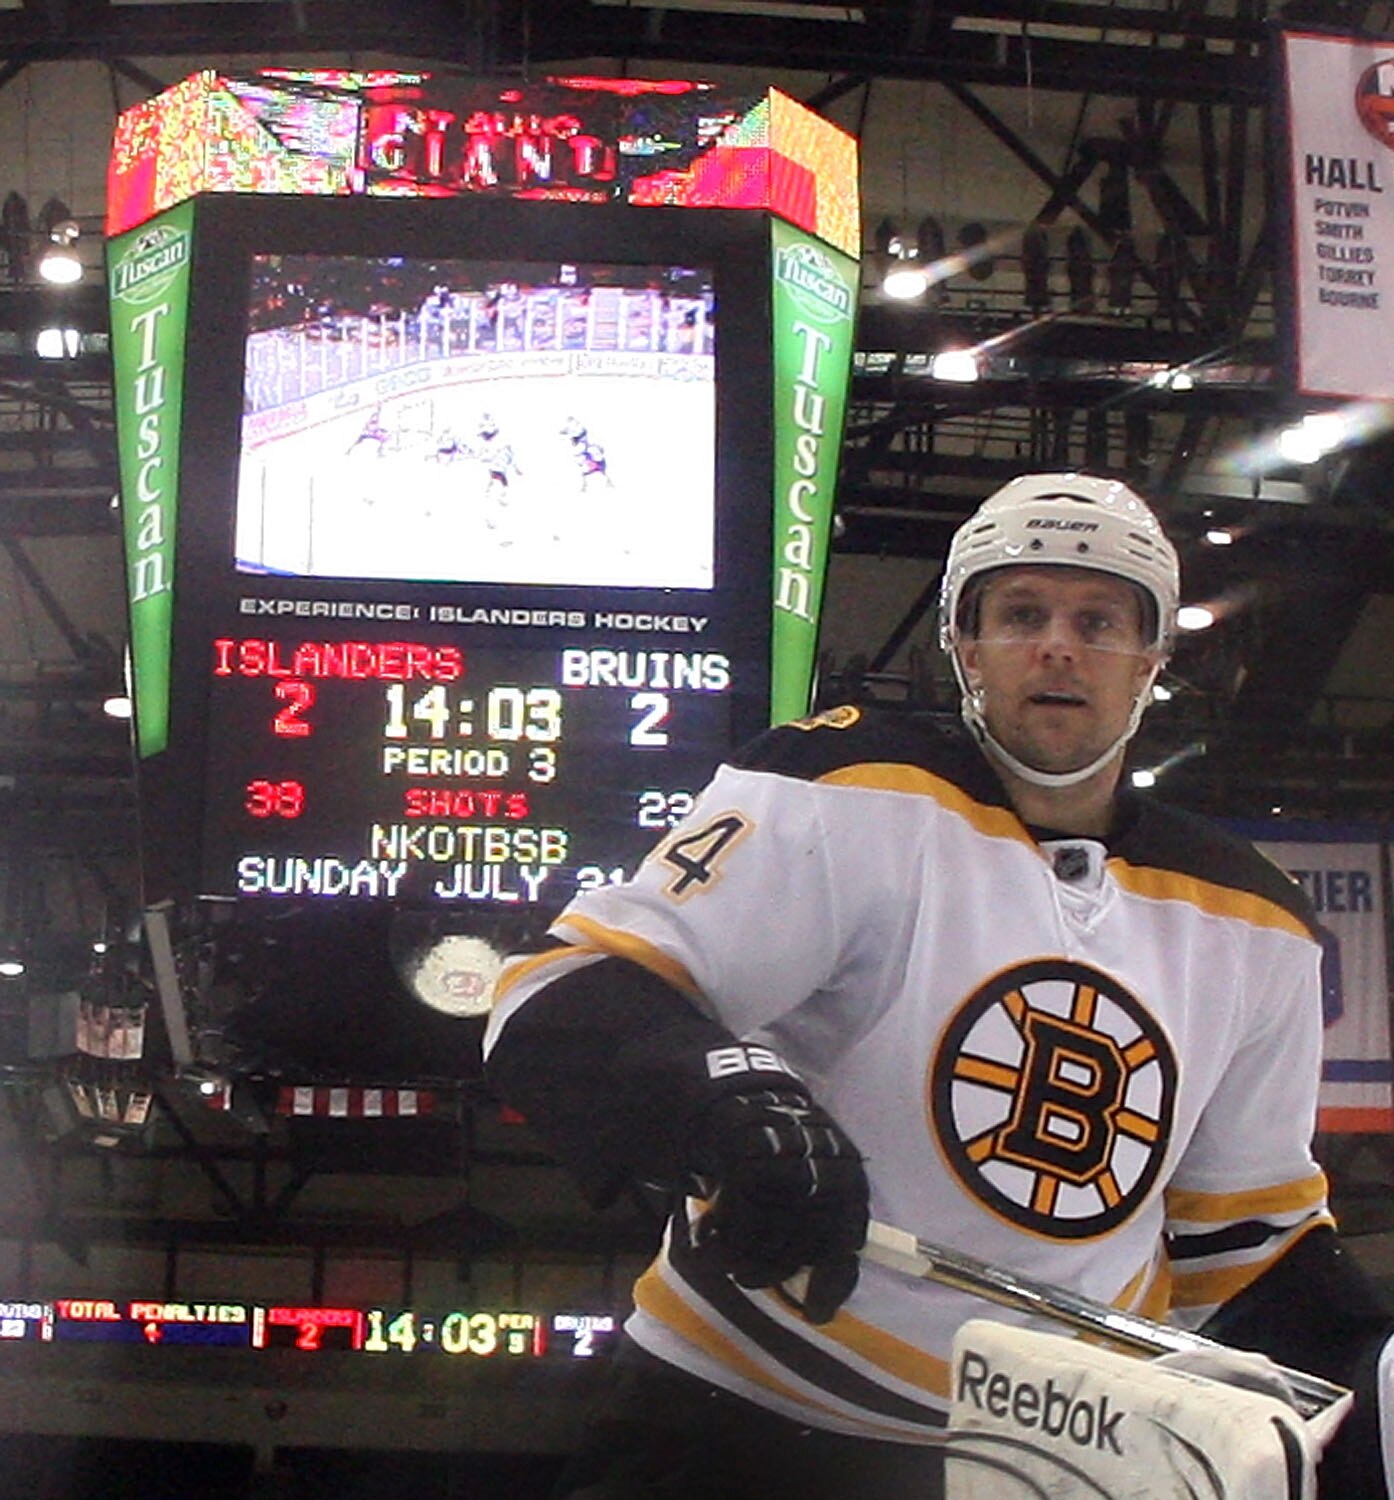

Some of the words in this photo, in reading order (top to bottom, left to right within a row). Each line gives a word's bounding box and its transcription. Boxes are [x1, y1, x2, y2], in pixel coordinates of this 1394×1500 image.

[1305, 153, 1383, 193] HALL
[1314, 198, 1370, 218] POTVIN
[1315, 221, 1364, 240] SMITH
[118, 241, 184, 290] Tuscan
[1316, 243, 1374, 263] GILLIES
[780, 255, 848, 310] Tuscan
[1318, 265, 1376, 286] TORREY
[130, 305, 172, 602] Tuscan
[775, 320, 832, 624] Tuscan
[1025, 518, 1099, 532] BAUER
[429, 606, 586, 628] ISLANDERS
[595, 613, 710, 632] HOCKEY
[215, 638, 464, 680] ISLANDERS
[561, 649, 730, 690] BRUINS
[273, 681, 314, 736] 2
[383, 685, 561, 741] 14:03
[629, 693, 669, 746] 2
[383, 749, 509, 777] PERIOD
[528, 752, 556, 782] 3
[405, 790, 529, 819] SHOTS
[371, 825, 568, 864] NKOTBSB
[663, 813, 752, 896] 4
[237, 860, 407, 896] SUNDAY
[436, 867, 546, 901] JULY
[996, 1012, 1126, 1186] B
[57, 1300, 121, 1321] TOTAL
[130, 1301, 246, 1323] PENALTIES
[299, 1322, 319, 1350] 2
[365, 1310, 497, 1355] 14:03
[574, 1330, 593, 1356] 2
[956, 1349, 1126, 1456] Reebok
